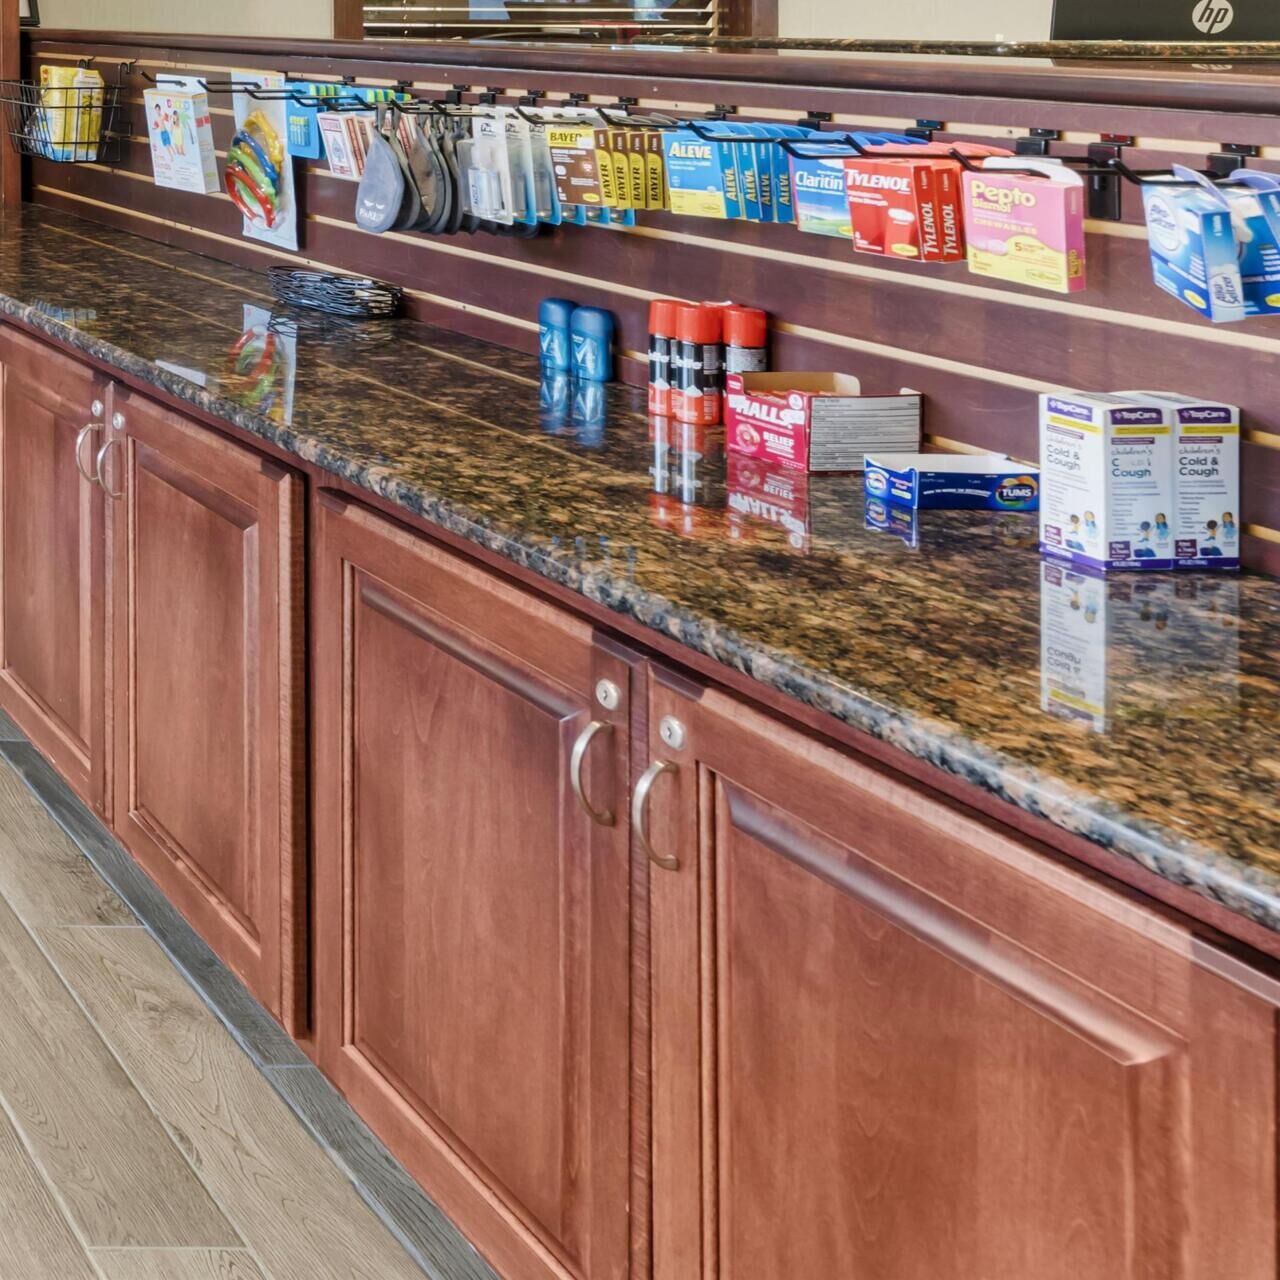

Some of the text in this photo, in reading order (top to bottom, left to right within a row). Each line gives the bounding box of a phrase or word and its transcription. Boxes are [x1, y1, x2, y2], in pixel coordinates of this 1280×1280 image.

[669, 142, 712, 159] ALEVE
[600, 163, 613, 199] BAYER
[616, 166, 627, 201] BAYER
[633, 166, 642, 201] BAYER
[650, 166, 659, 201] BAYER
[724, 166, 738, 201] ALEVE
[744, 167, 757, 202] ALEVE
[760, 173, 772, 205] ALEVE
[779, 173, 791, 205] ALEVE
[795, 171, 843, 190] Claritin
[845, 169, 912, 191] TYLENOL
[971, 180, 1036, 207] Pepto
[921, 202, 939, 255] TYLENOL
[942, 203, 959, 256] TYLENOL
[1056, 401, 1090, 415] TopCare
[1120, 410, 1158, 420] TopCare
[1189, 410, 1227, 419] TopCare
[1047, 445, 1081, 461] Cold &
[1047, 455, 1081, 471] Cough
[1179, 456, 1218, 466] Cold &
[1111, 468, 1152, 479] Cough
[1178, 466, 1219, 477] Cough
[1002, 488, 1032, 498] TUMS
